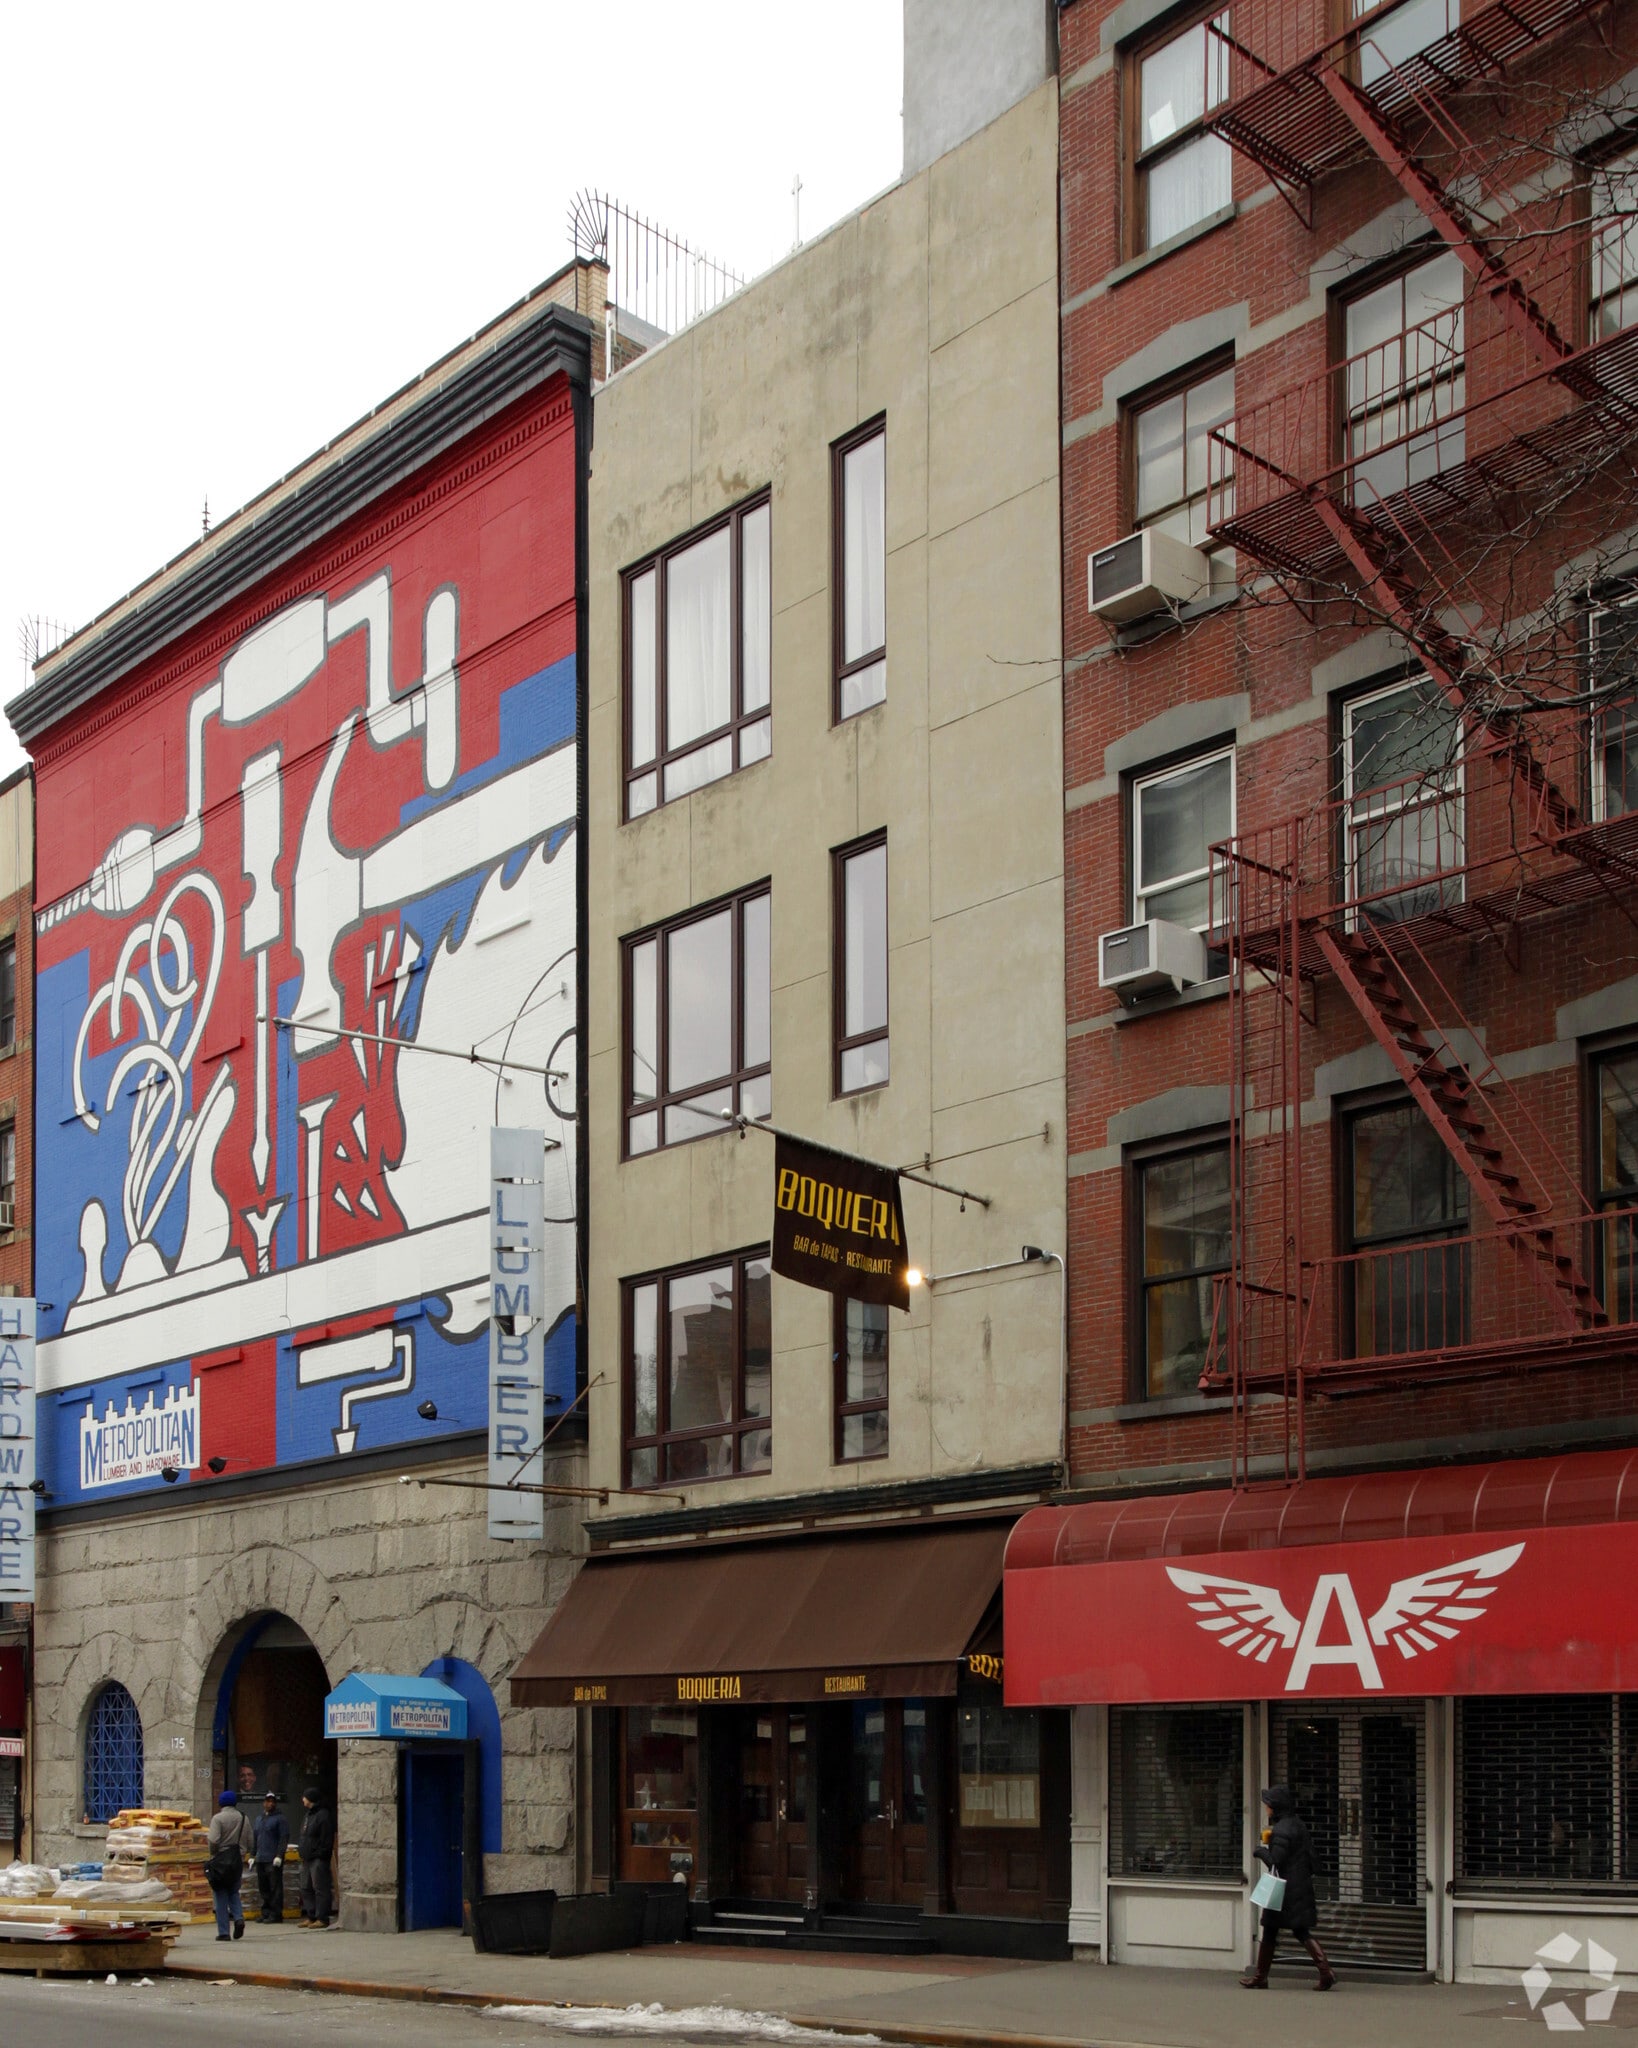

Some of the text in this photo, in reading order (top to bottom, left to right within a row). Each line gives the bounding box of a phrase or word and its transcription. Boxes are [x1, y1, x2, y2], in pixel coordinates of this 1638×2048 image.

[793, 1234, 810, 1254] BAR
[809, 1240, 820, 1257] de
[820, 1242, 840, 1263] TAPAS
[493, 1189, 530, 1463] LUMBER
[0, 1308, 24, 1580] HARDWARE
[85, 1407, 195, 1484] METROPOLITAN
[103, 1453, 181, 1481] LUMBER AND HARDWARE
[678, 1676, 741, 1703] BOQUERIA
[824, 1675, 866, 1693] RESTAURANTE
[329, 1710, 375, 1731] METROPOLITAN
[392, 1711, 449, 1729] METROPOLITAN
[0, 1741, 20, 1753] ATM
[171, 1737, 186, 1750] 175
